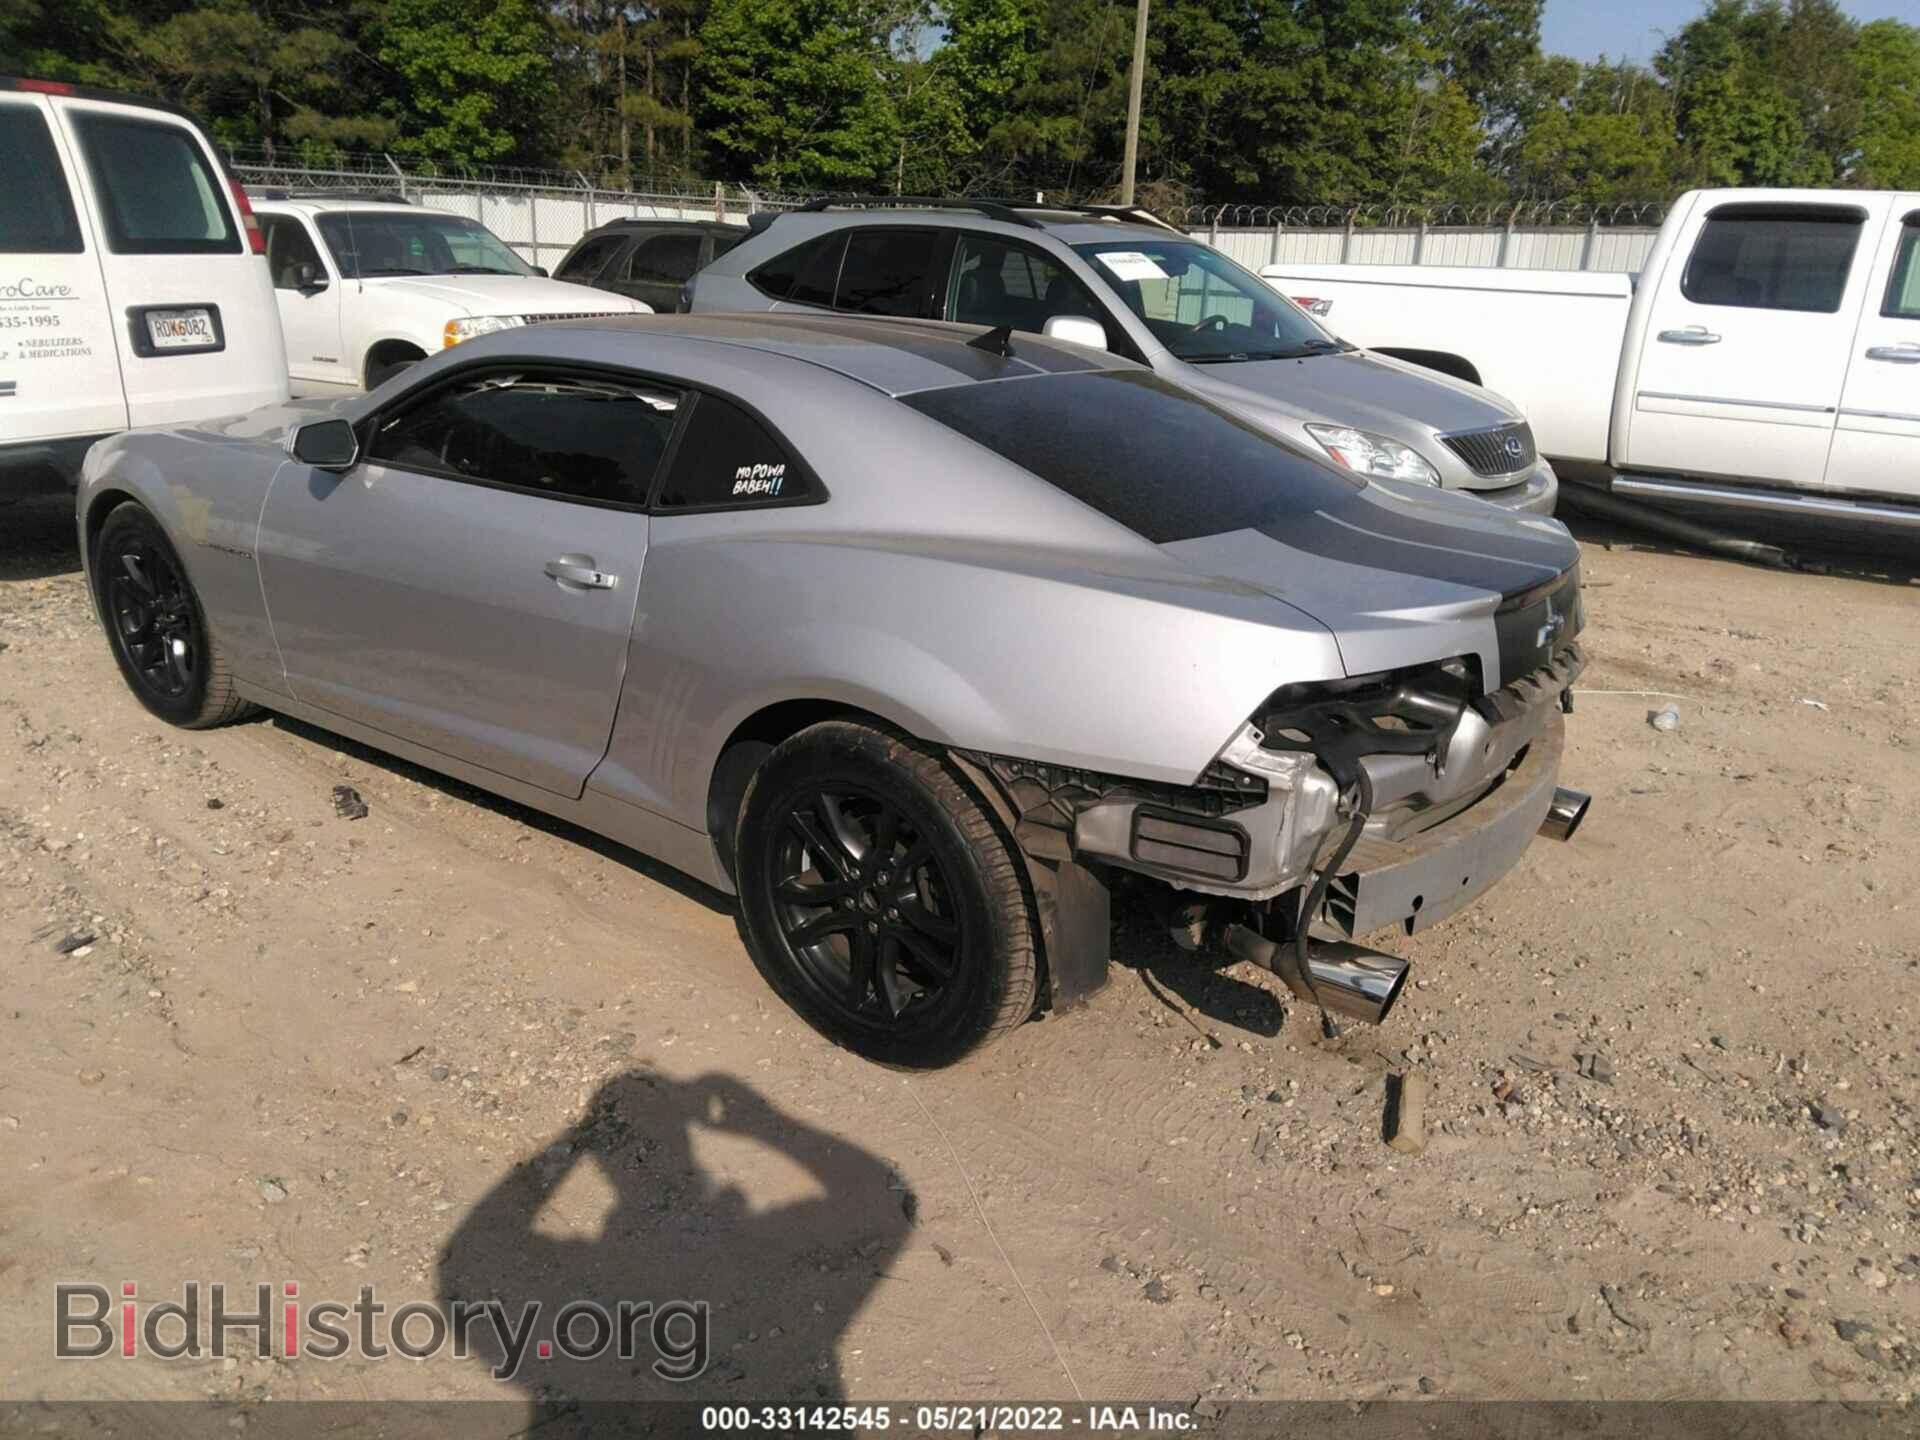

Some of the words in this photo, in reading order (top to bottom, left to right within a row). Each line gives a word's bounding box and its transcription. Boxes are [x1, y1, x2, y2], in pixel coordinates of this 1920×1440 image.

[154, 319, 208, 337] RDK6082
[25, 337, 83, 347] NEBULIZERS
[28, 347, 92, 358] MEDICATIONS
